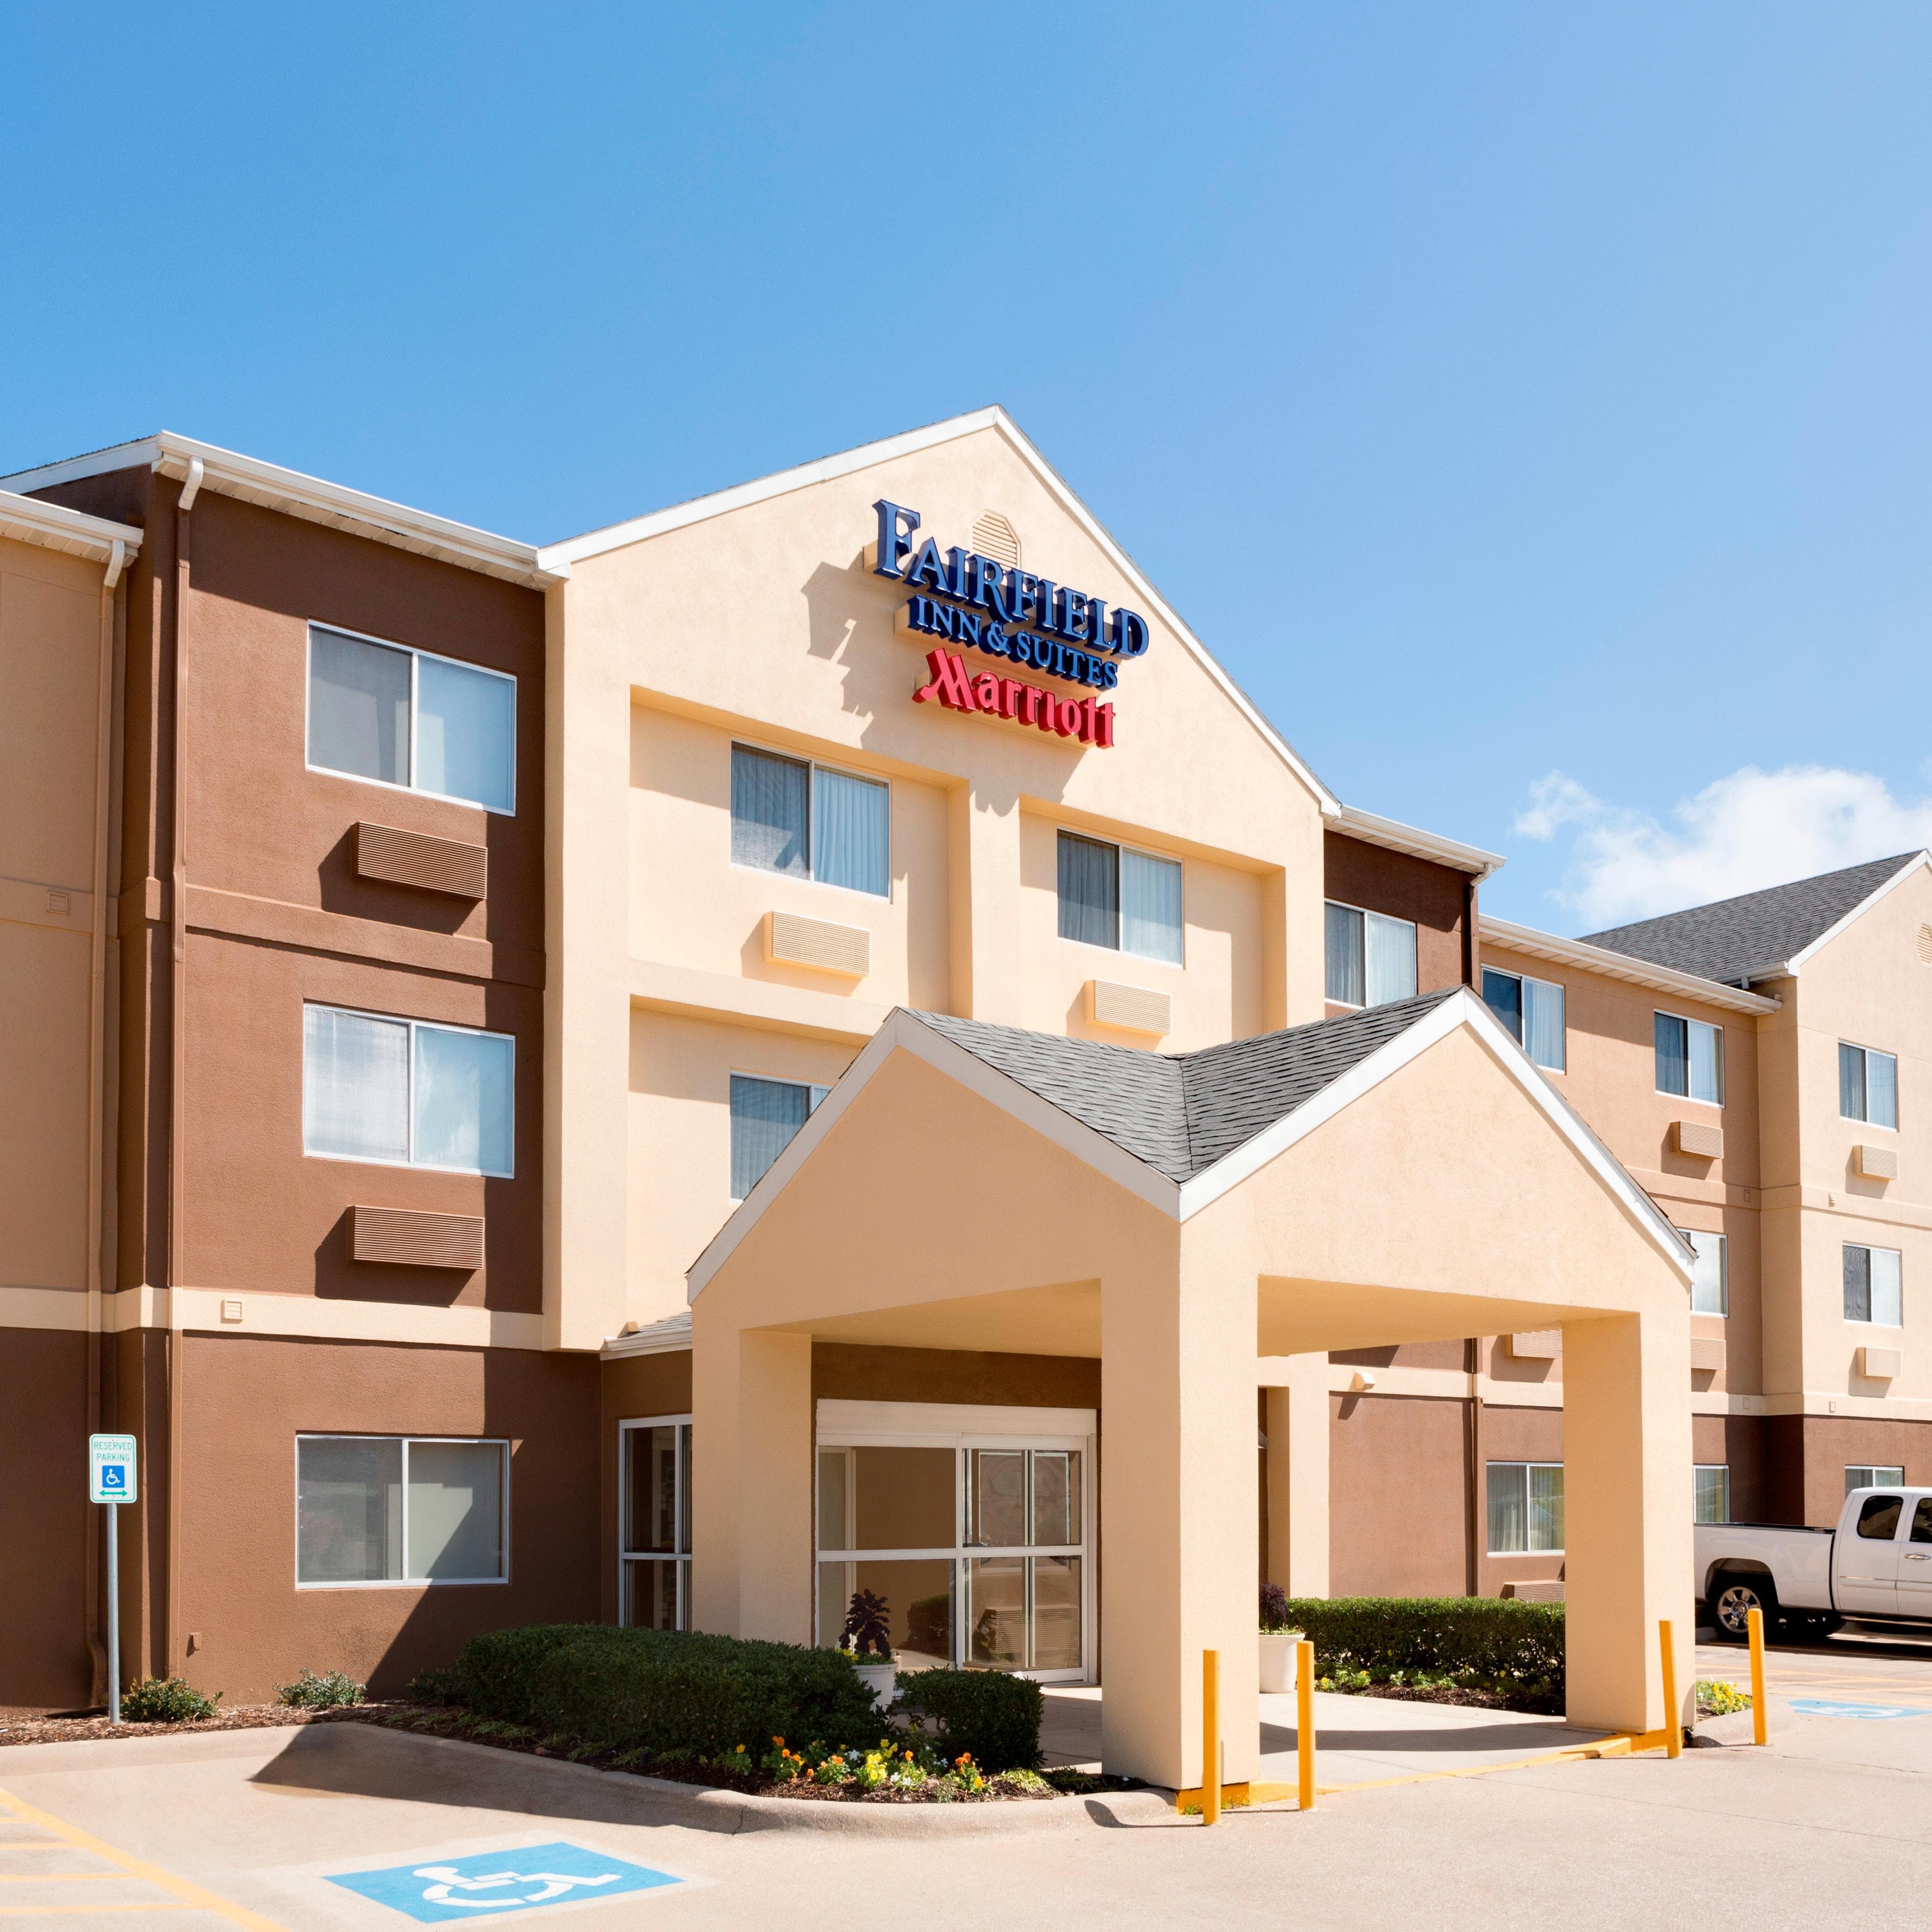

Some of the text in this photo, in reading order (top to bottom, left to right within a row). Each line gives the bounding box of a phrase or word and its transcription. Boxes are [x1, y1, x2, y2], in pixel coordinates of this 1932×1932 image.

[872, 499, 1149, 660] FAIRFIELD
[908, 594, 1118, 692] INN & SUITES
[912, 648, 1116, 749] Marriott
[94, 1442, 132, 1450] RESERVED
[97, 1453, 130, 1462] PARKING
